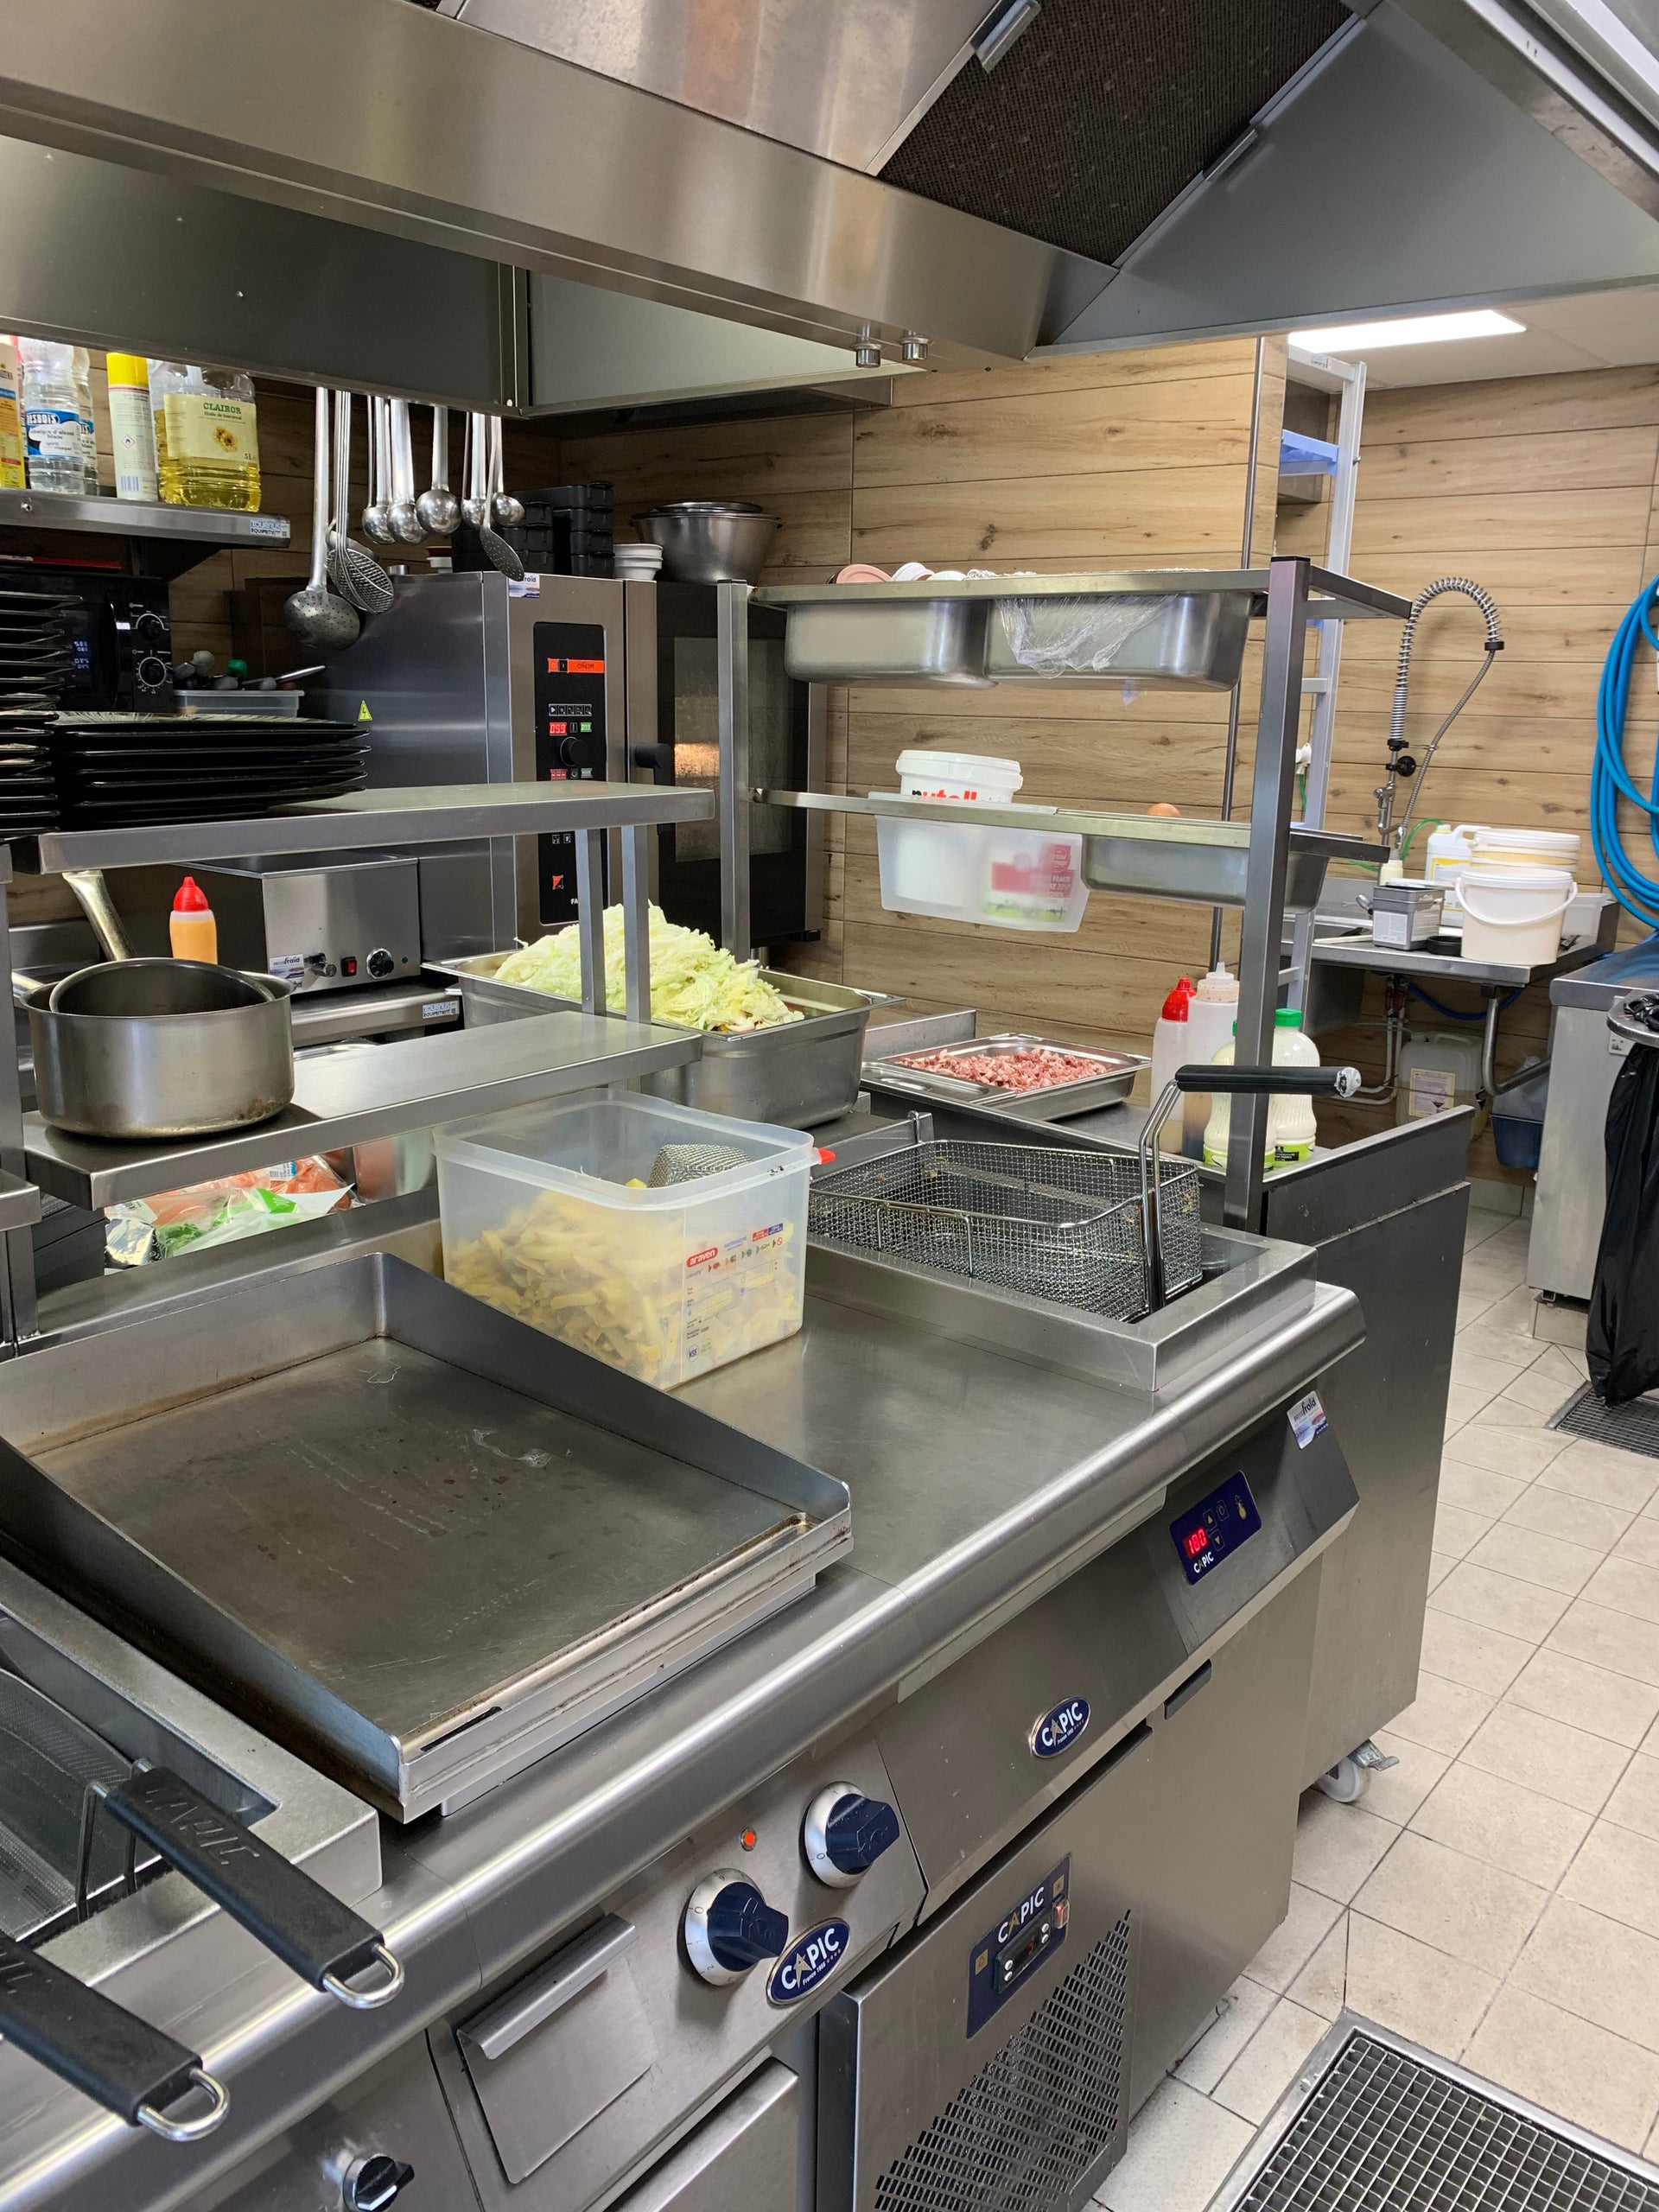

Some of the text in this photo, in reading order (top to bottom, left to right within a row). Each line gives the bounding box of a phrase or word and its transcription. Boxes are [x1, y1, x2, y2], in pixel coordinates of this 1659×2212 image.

[203, 402, 242, 415] CLAIROR
[912, 789, 979, 801] ntll
[690, 1249, 715, 1266] araven
[1193, 1552, 1214, 1573] CAPIC
[1041, 1702, 1083, 1746] CAPIC
[997, 1886, 1045, 1943] CAPIC
[781, 1928, 840, 1989] CAPIC
[803, 1970, 817, 1986] France
